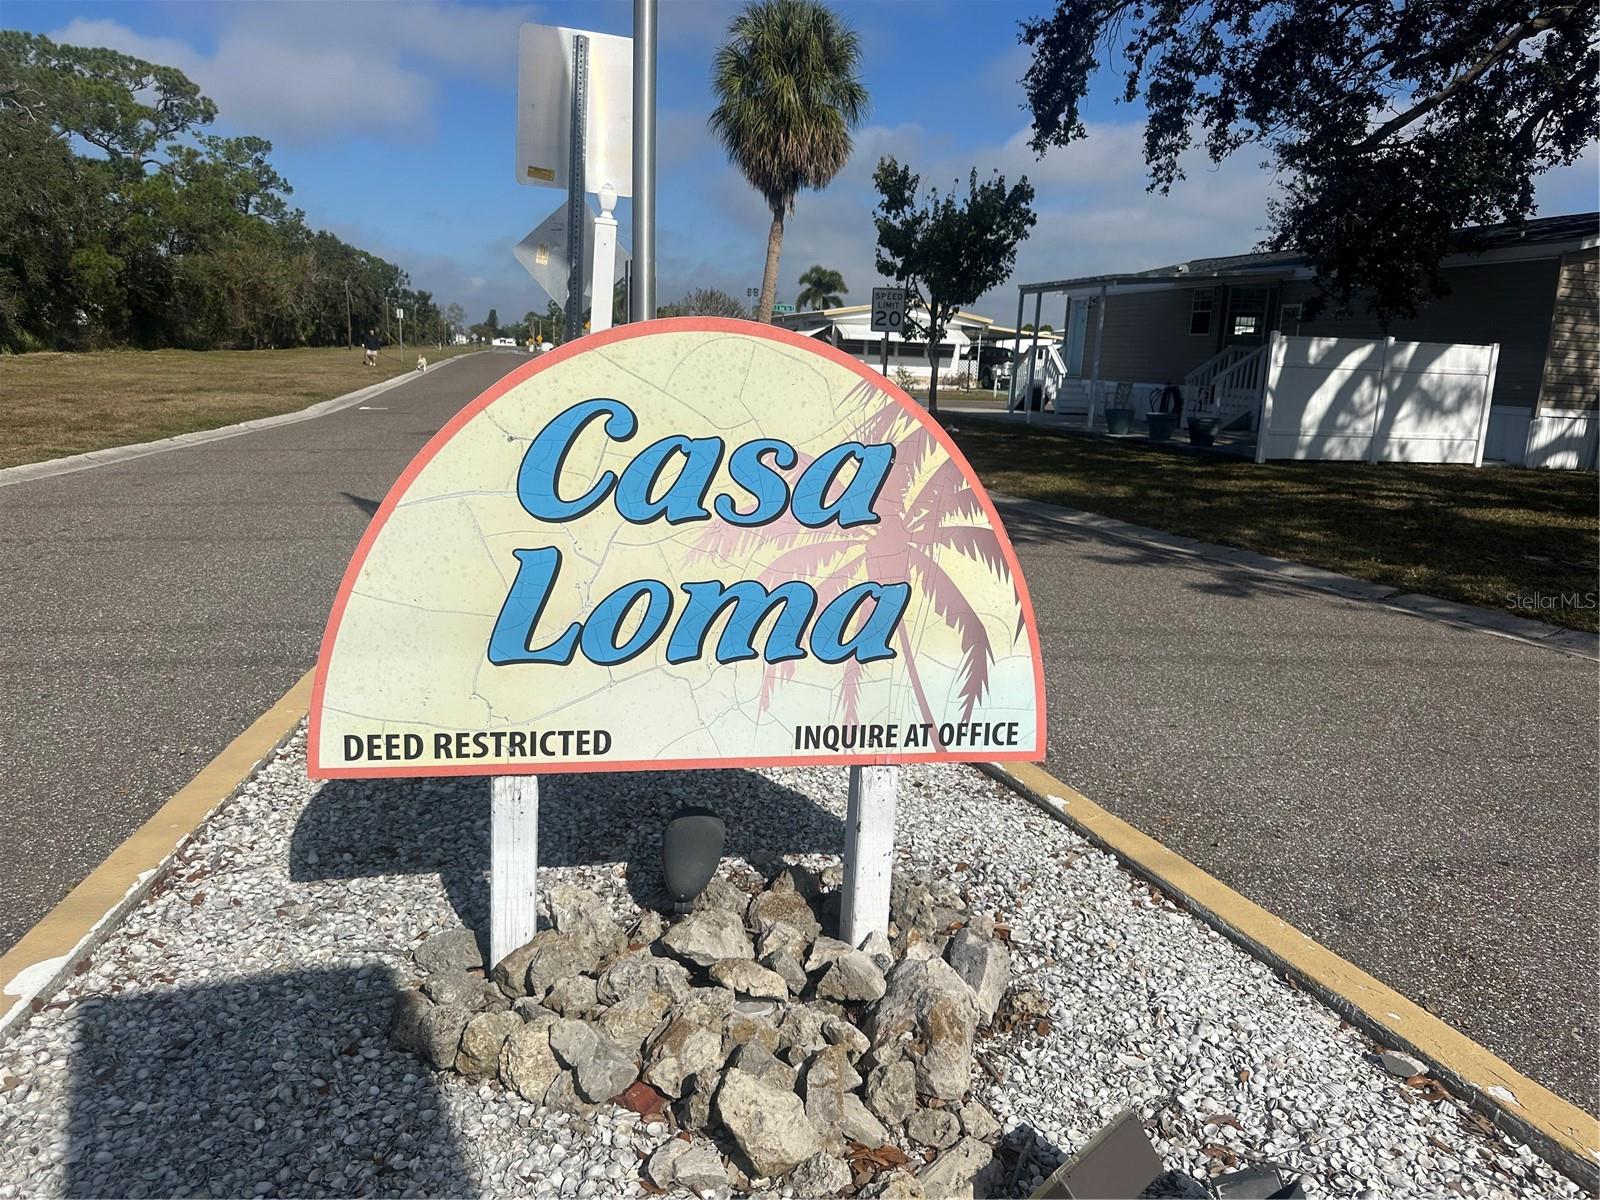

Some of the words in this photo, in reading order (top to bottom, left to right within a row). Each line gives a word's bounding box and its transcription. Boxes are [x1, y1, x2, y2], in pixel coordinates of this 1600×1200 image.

[875, 311, 901, 326] 20
[877, 302, 899, 310] LIMIT
[516, 398, 896, 528] Casa
[487, 546, 911, 667] Loma
[343, 733, 424, 761] DEED
[433, 730, 612, 759] RESTRICTED
[794, 724, 898, 752] INQUIRE
[903, 723, 933, 747] AT
[938, 721, 1019, 747] OFFICE
